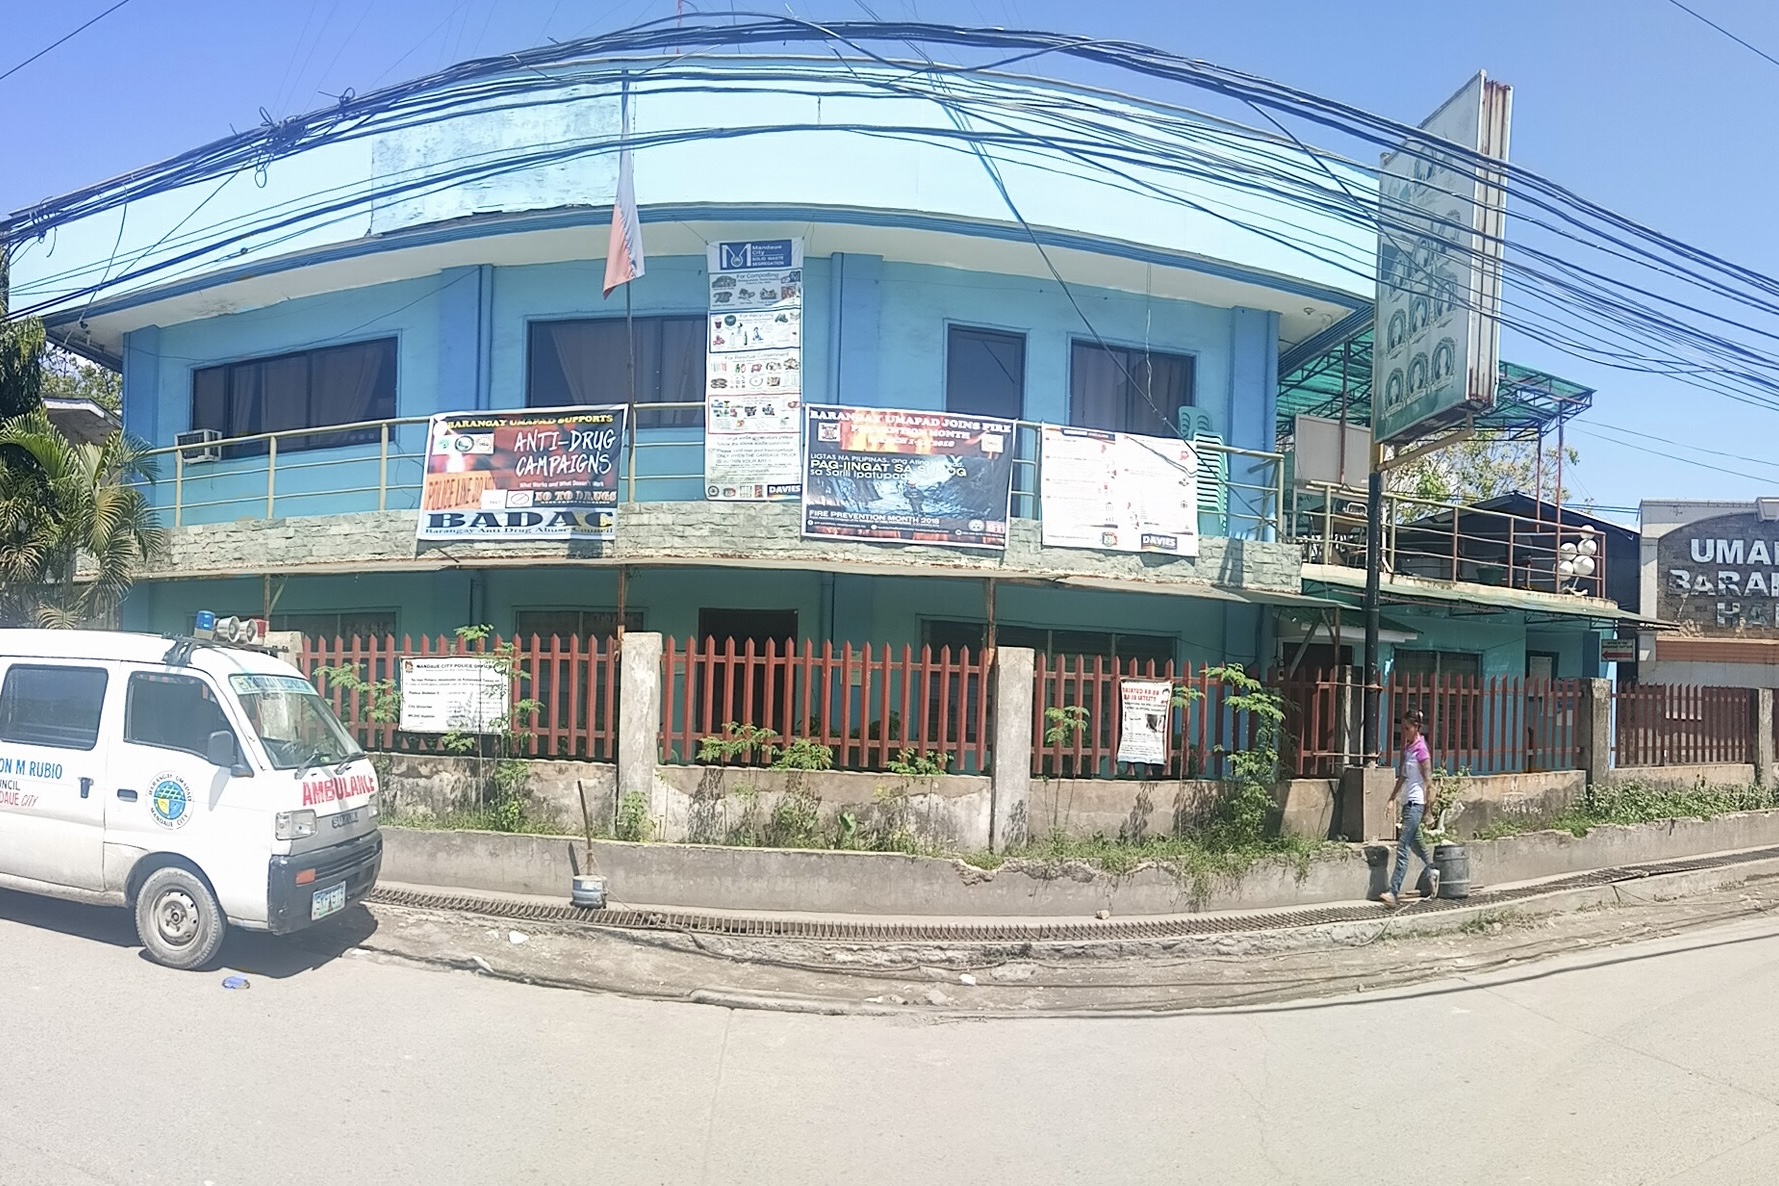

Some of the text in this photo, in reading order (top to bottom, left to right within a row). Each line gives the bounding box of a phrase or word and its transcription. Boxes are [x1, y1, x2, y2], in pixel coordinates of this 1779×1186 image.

[447, 419, 507, 429] BARANGAY
[557, 414, 614, 425] SUPPORTS
[941, 418, 981, 431] JOINS
[982, 422, 1012, 433] FIRE
[513, 428, 617, 453] ANTI-DRUG
[930, 429, 971, 440] MONTH
[516, 452, 612, 477] CAMPAIGNS
[810, 459, 891, 473] PAG-IINGAT
[894, 463, 913, 474] SA
[810, 468, 823, 476] sa
[534, 490, 618, 502] NO TO DRUGS
[768, 485, 801, 494] DAVIES
[426, 511, 614, 529] BADAC
[809, 509, 829, 517] FIRE
[830, 511, 886, 521] PREVENTION
[886, 515, 919, 524] MONTH
[920, 517, 940, 525] 2018
[1142, 535, 1176, 546] DAVIES
[1691, 538, 1779, 566] UMA
[1669, 570, 1779, 597] BARA
[1717, 603, 1779, 628] HA
[15, 759, 26, 776] M
[29, 760, 63, 780] RUBIO
[302, 774, 375, 807] AMBULANCE
[20, 794, 39, 807] CITY
